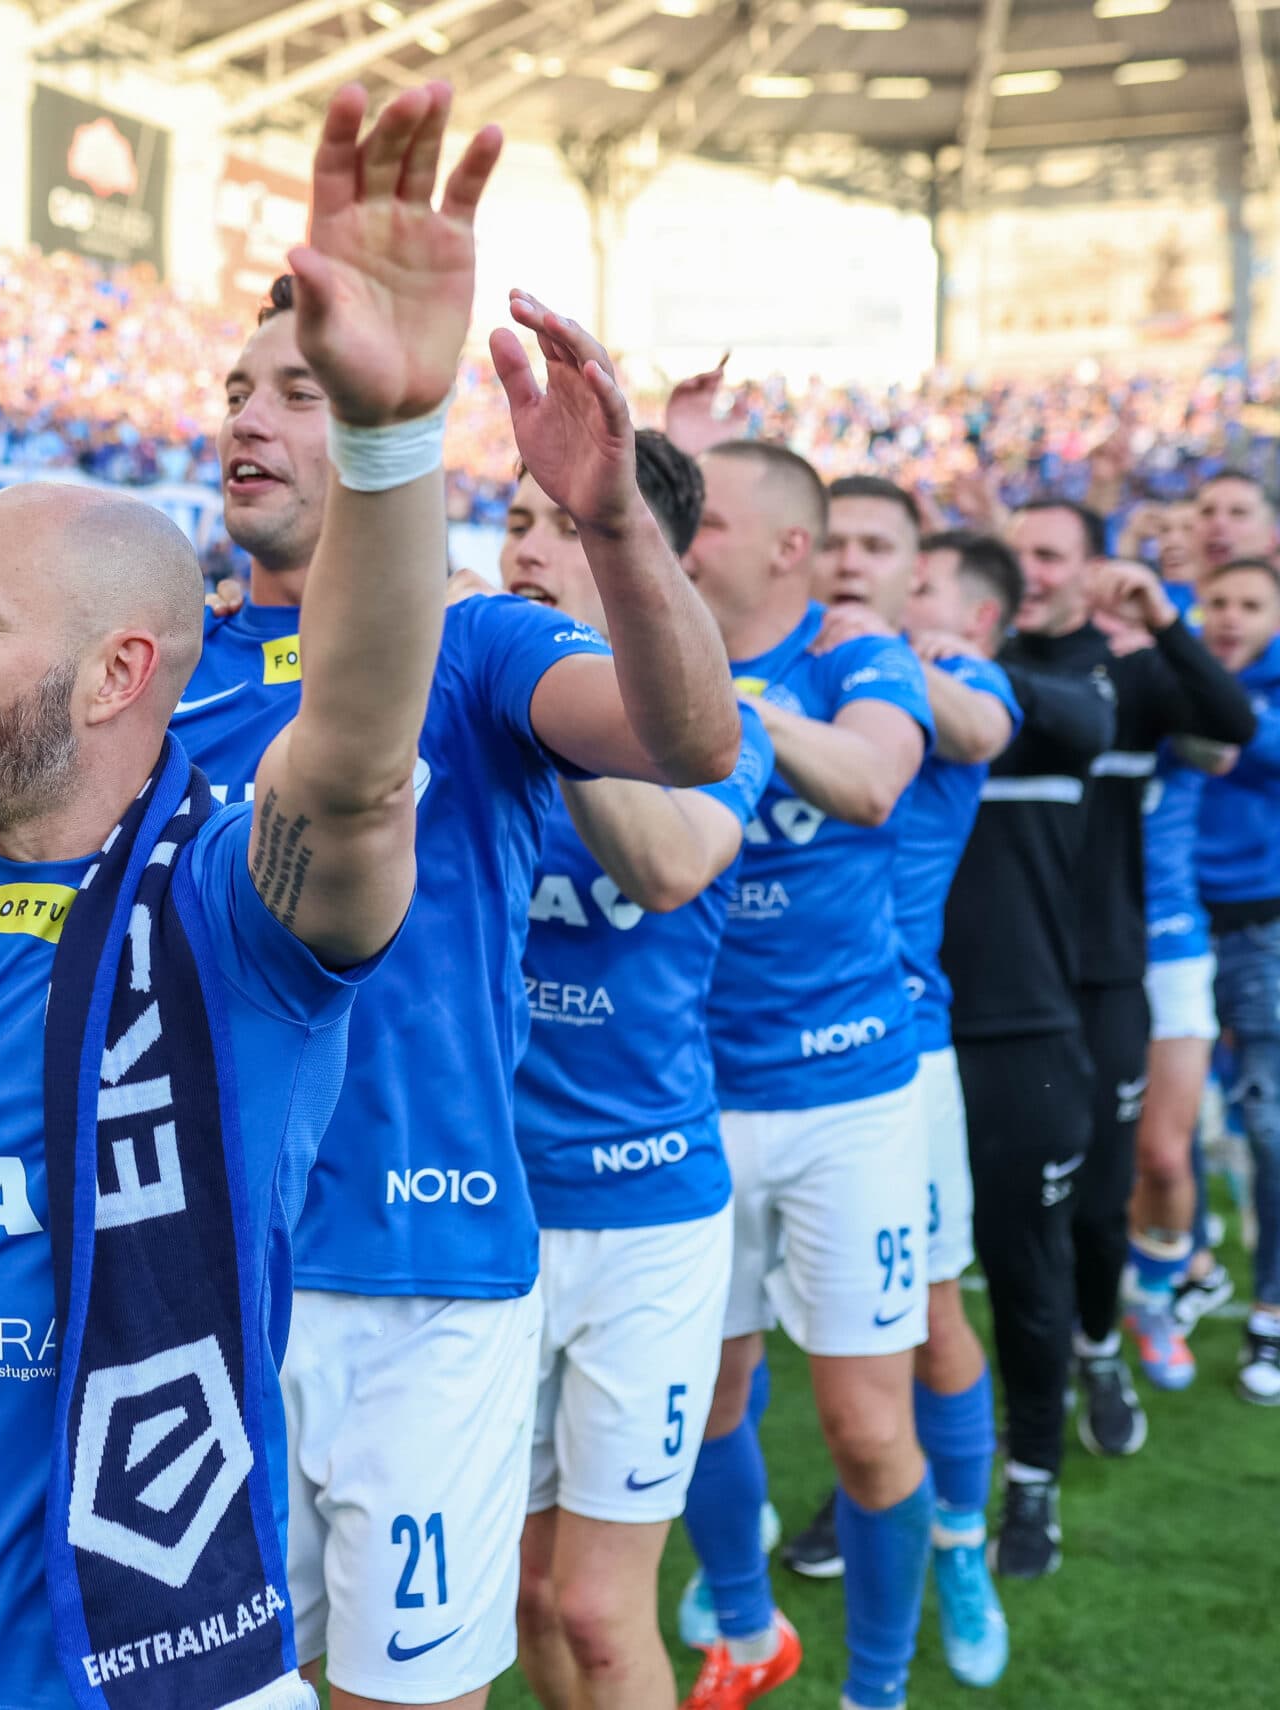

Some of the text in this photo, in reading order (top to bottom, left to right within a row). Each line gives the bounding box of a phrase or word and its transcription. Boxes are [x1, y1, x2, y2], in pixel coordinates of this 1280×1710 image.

[522, 976, 616, 1017] ZERA
[386, 1166, 498, 1207] NO10
[876, 1226, 914, 1292] 95
[664, 1385, 688, 1457] 5
[391, 1511, 448, 1610] 21
[81, 1583, 286, 1689] EKSTRAKLASA
